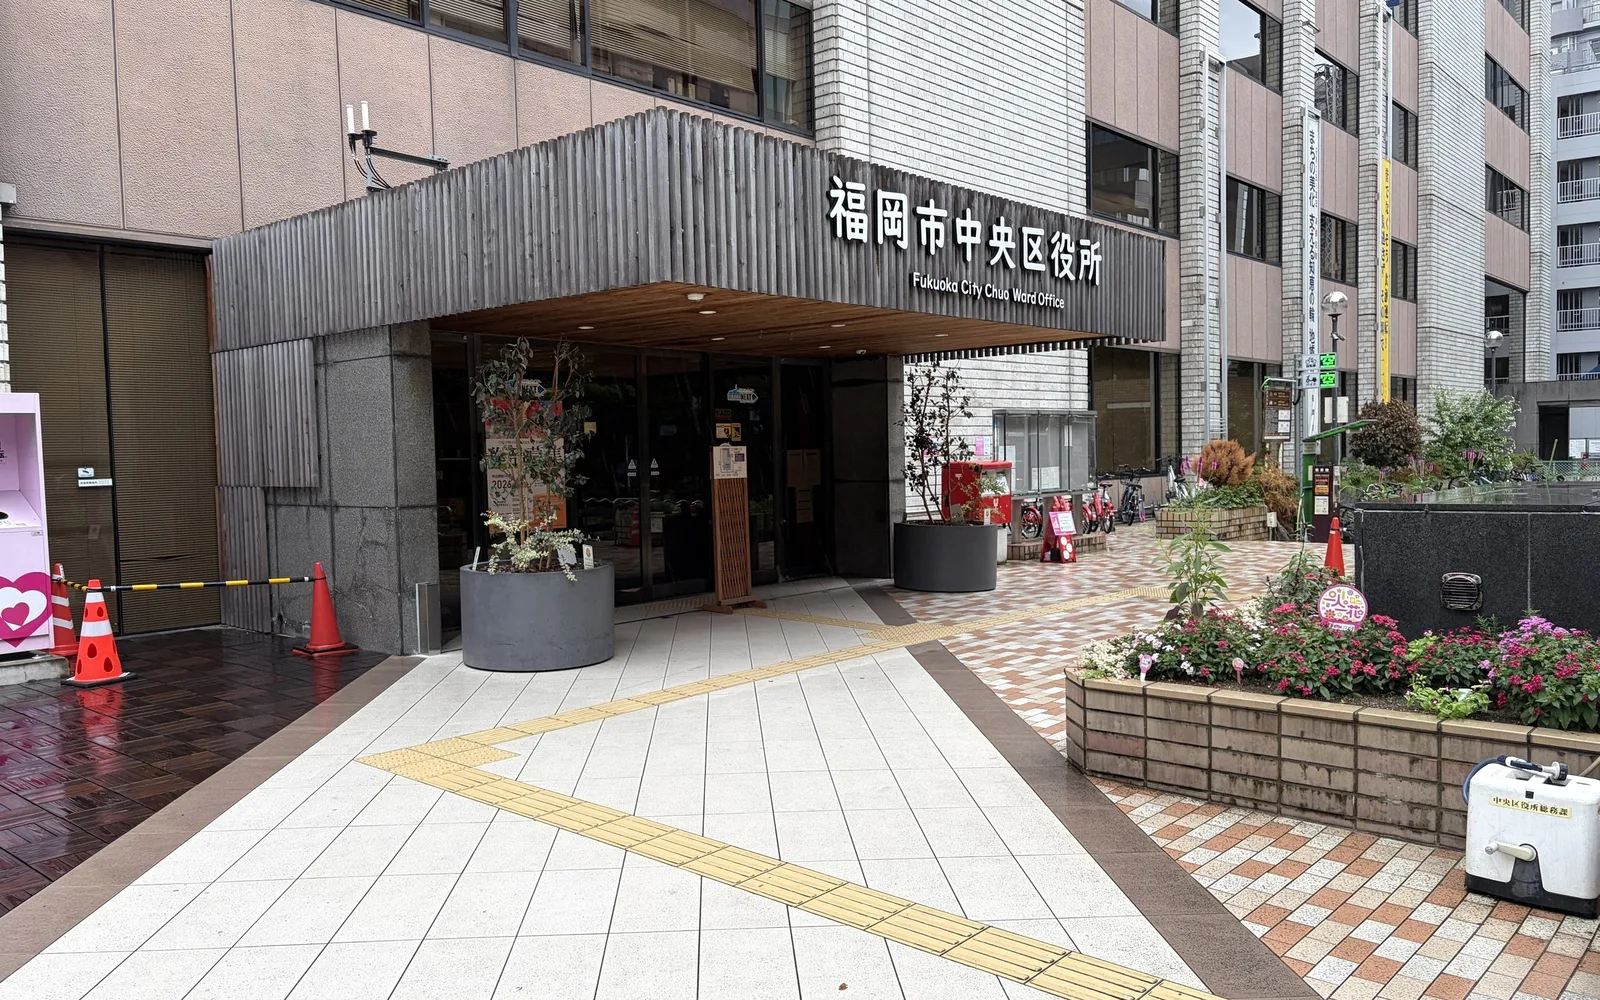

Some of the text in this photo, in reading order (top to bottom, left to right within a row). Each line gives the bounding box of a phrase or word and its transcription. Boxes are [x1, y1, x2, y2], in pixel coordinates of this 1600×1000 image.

[1308, 129, 1316, 208] まちの美化
[829, 175, 1102, 286] 福岡市中央区役所
[913, 271, 1065, 309] Fukuoka City Chuo Ward Office
[1320, 353, 1336, 368] 空
[1320, 372, 1336, 387] 空
[491, 479, 512, 490] 2026
[1323, 594, 1361, 619] 一人一花
[1492, 796, 1569, 816] 中央区役所総務課
